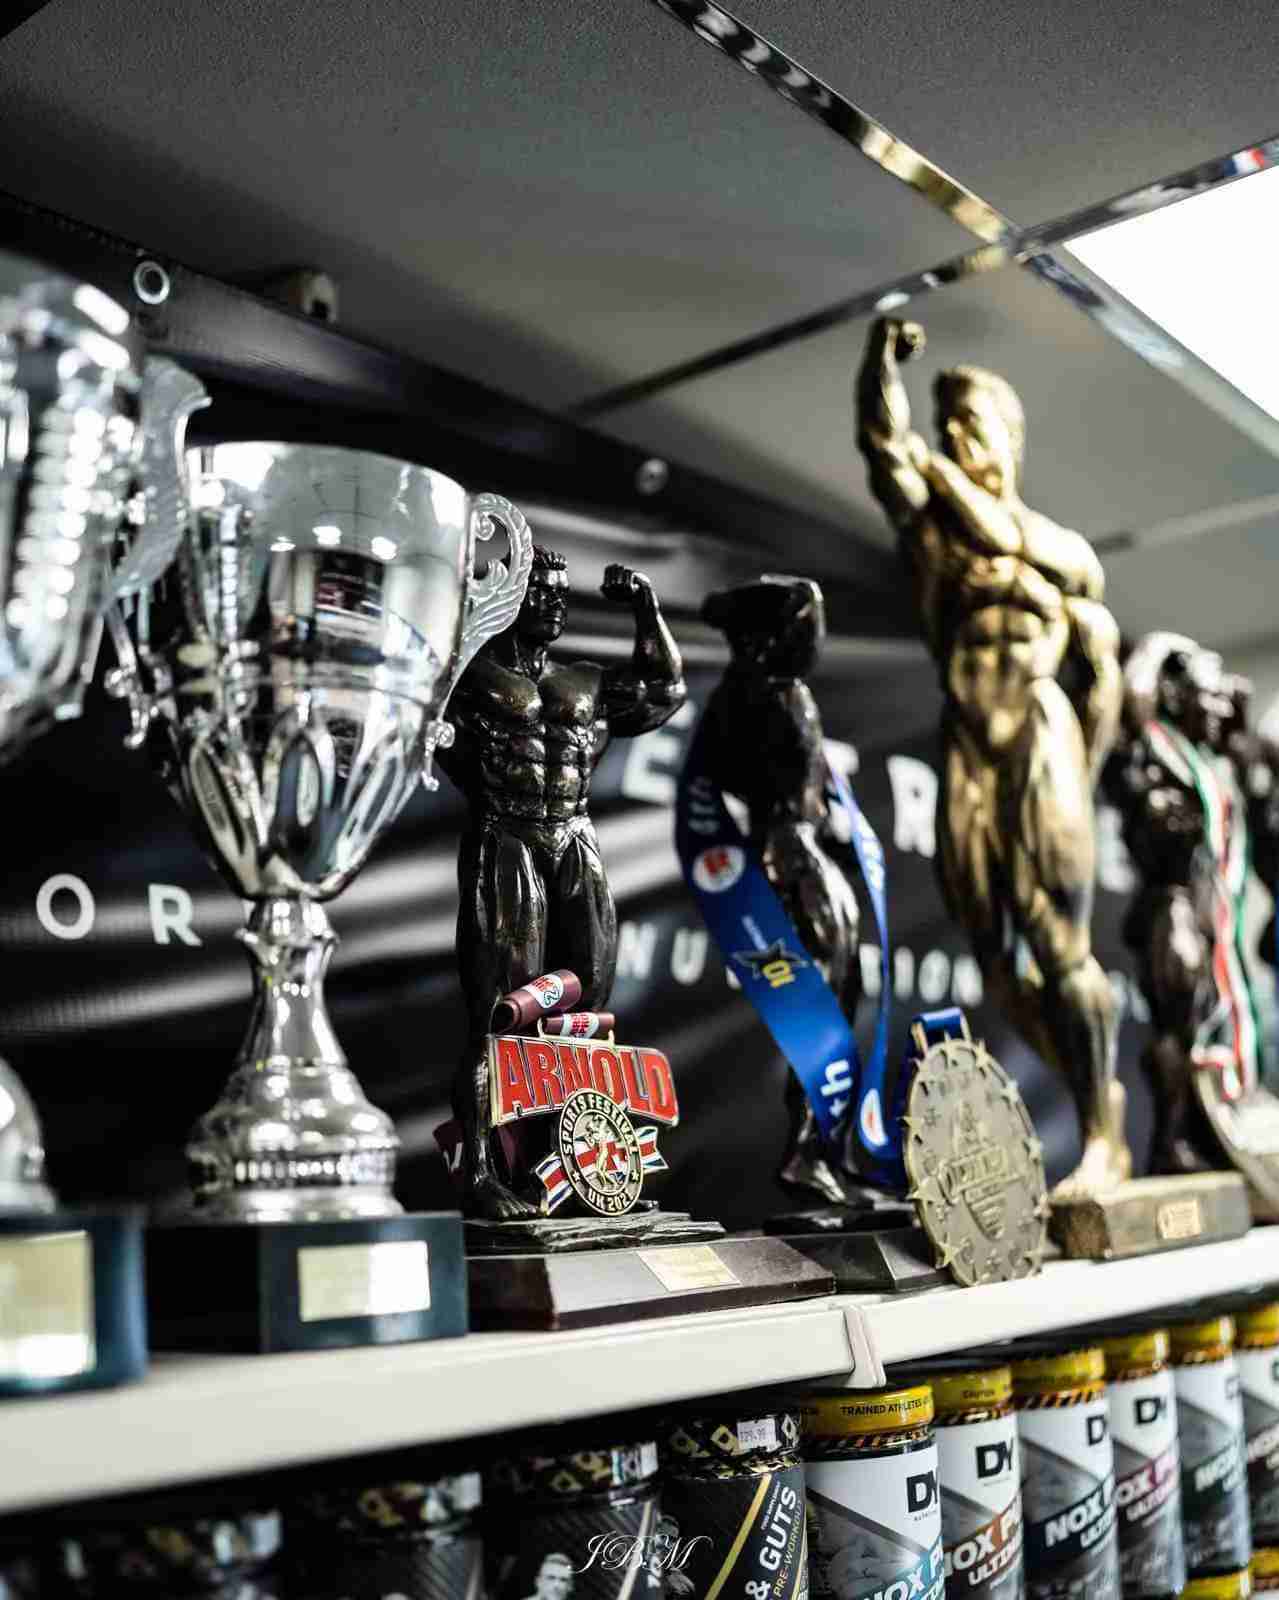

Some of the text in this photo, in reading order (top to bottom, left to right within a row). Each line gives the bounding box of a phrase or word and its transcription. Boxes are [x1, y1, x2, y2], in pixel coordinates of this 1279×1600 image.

[495, 1037, 678, 1125] ARNOLD
[561, 1093, 638, 1155] SPORTS FESTIVAL
[587, 1187, 606, 1211] UK
[840, 1403, 887, 1417] TRAINED
[887, 1398, 923, 1413] ATHLETES
[745, 1579, 771, 1600] &
[759, 1486, 798, 1572] GUTS
[1045, 1488, 1104, 1549] NOX
